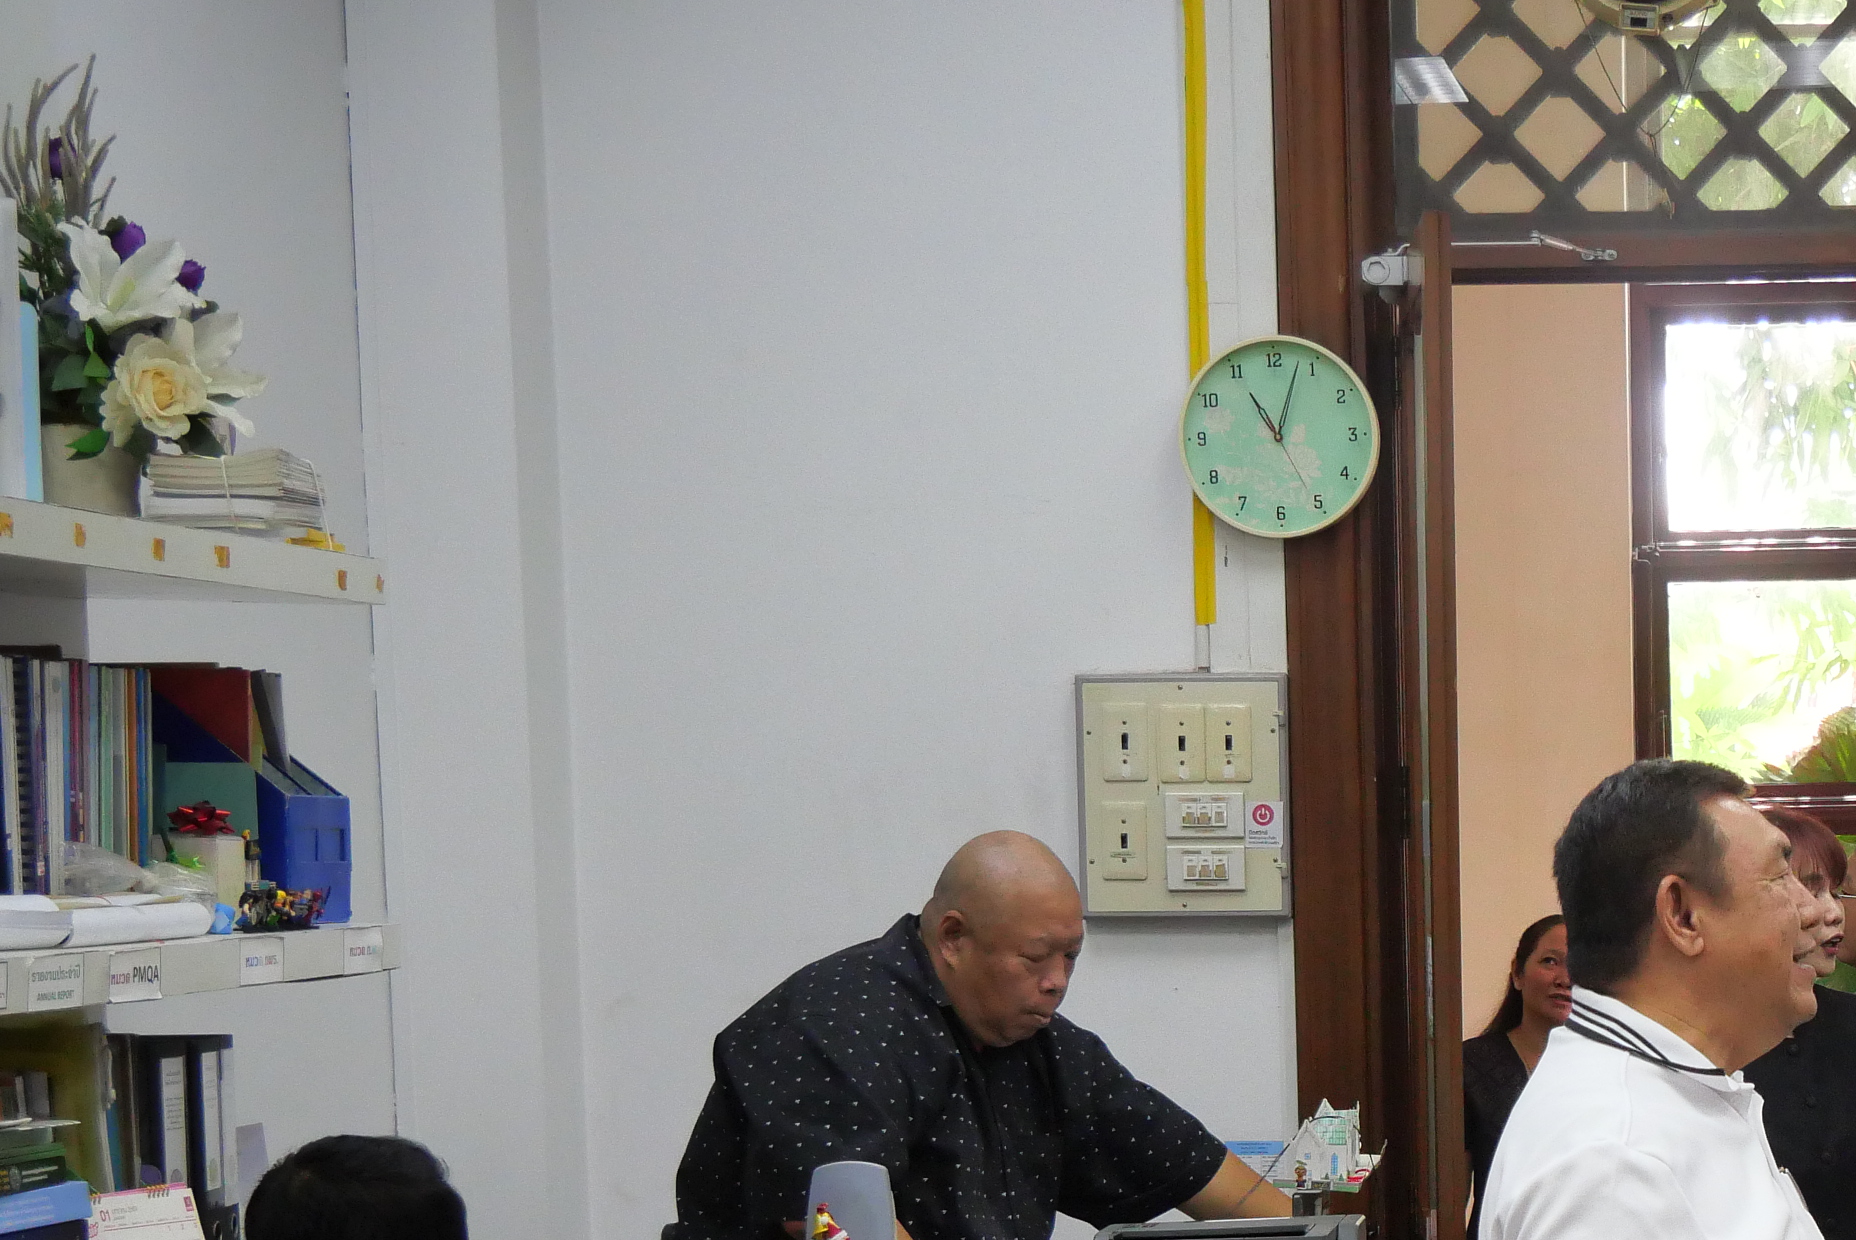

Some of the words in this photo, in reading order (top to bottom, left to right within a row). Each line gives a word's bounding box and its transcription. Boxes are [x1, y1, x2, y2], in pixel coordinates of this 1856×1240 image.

[1266, 353, 1282, 368] 12
[1230, 365, 1243, 379] 11
[1309, 362, 1315, 377] 1
[1202, 393, 1219, 408] 10
[1336, 389, 1346, 404] 2
[1197, 431, 1207, 446] 9
[1348, 427, 1358, 442] 3
[1209, 470, 1219, 484] 8
[1340, 466, 1350, 480] 4
[1238, 496, 1247, 511] 7
[1313, 494, 1323, 509] 5
[1276, 506, 1286, 521] 6
[132, 965, 159, 984] PMQA
[100, 1209, 111, 1222] 01
